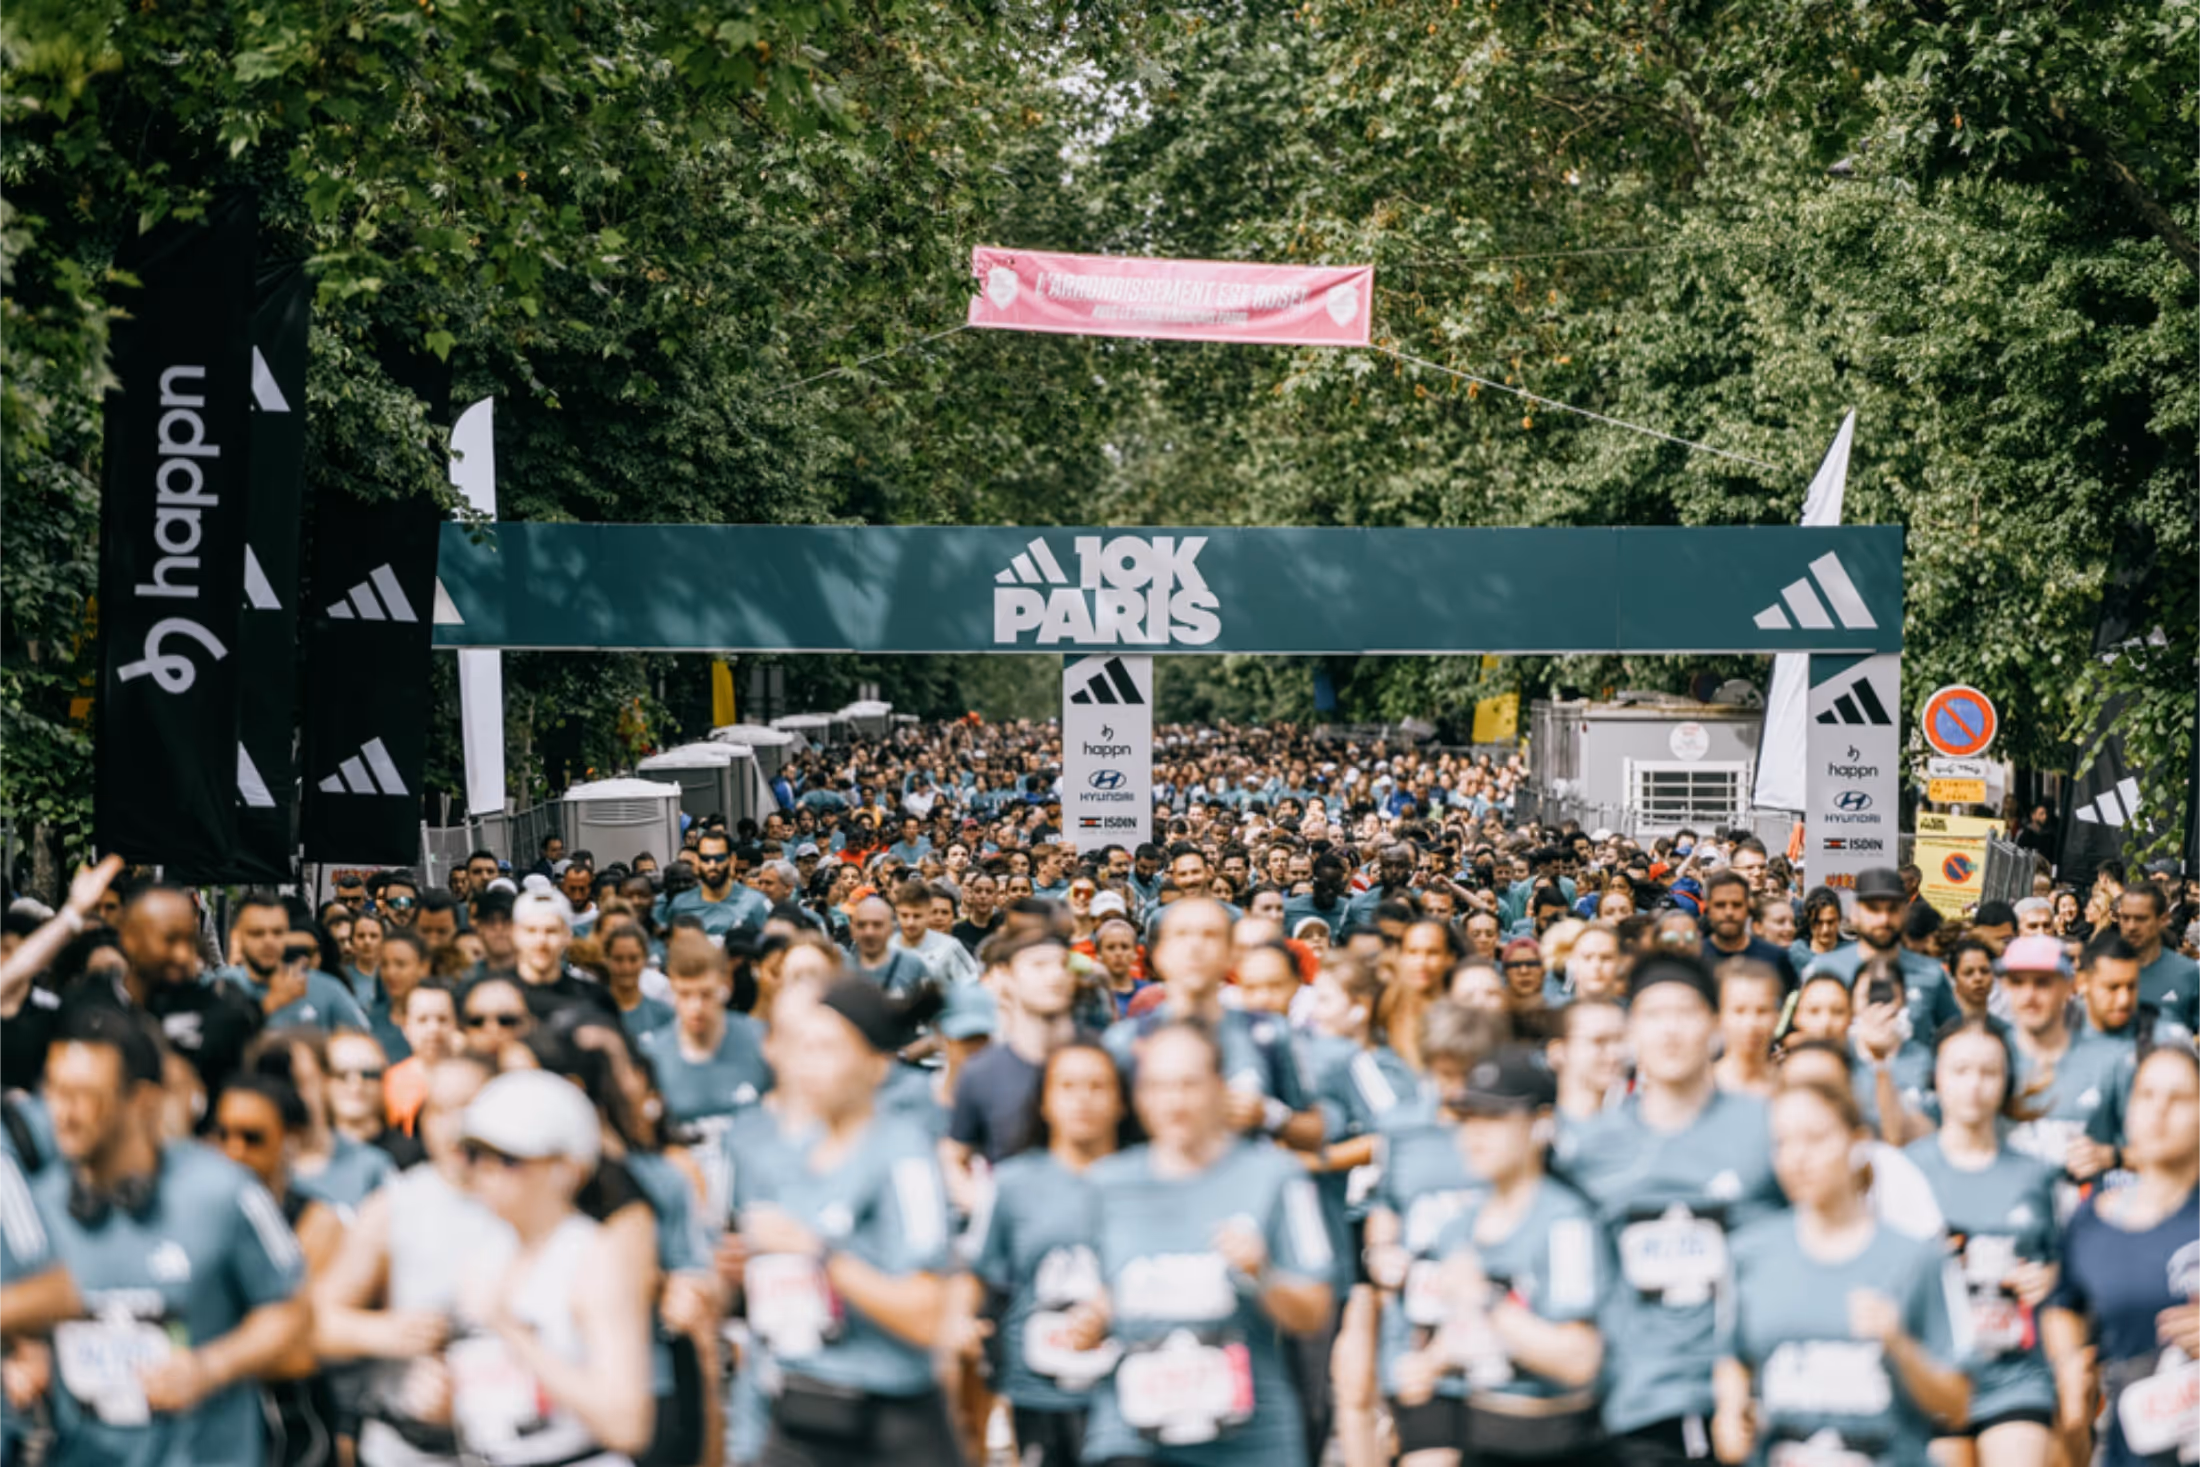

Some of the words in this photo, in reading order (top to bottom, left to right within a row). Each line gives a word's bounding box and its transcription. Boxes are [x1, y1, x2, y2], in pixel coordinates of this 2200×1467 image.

[1035, 272, 1215, 306] L'ARRONDISSEMENT
[1216, 281, 1251, 308] EST
[135, 364, 220, 597] happn
[1075, 536, 1209, 590] 10K
[994, 587, 1221, 645] PARIS
[1083, 741, 1131, 758] happn
[1828, 763, 1879, 779] happn
[1080, 792, 1135, 802] HYUNDAI
[1104, 816, 1137, 829] ISDIN
[1824, 813, 1881, 824] HYUNDAI
[1849, 837, 1883, 850] ISDIN
